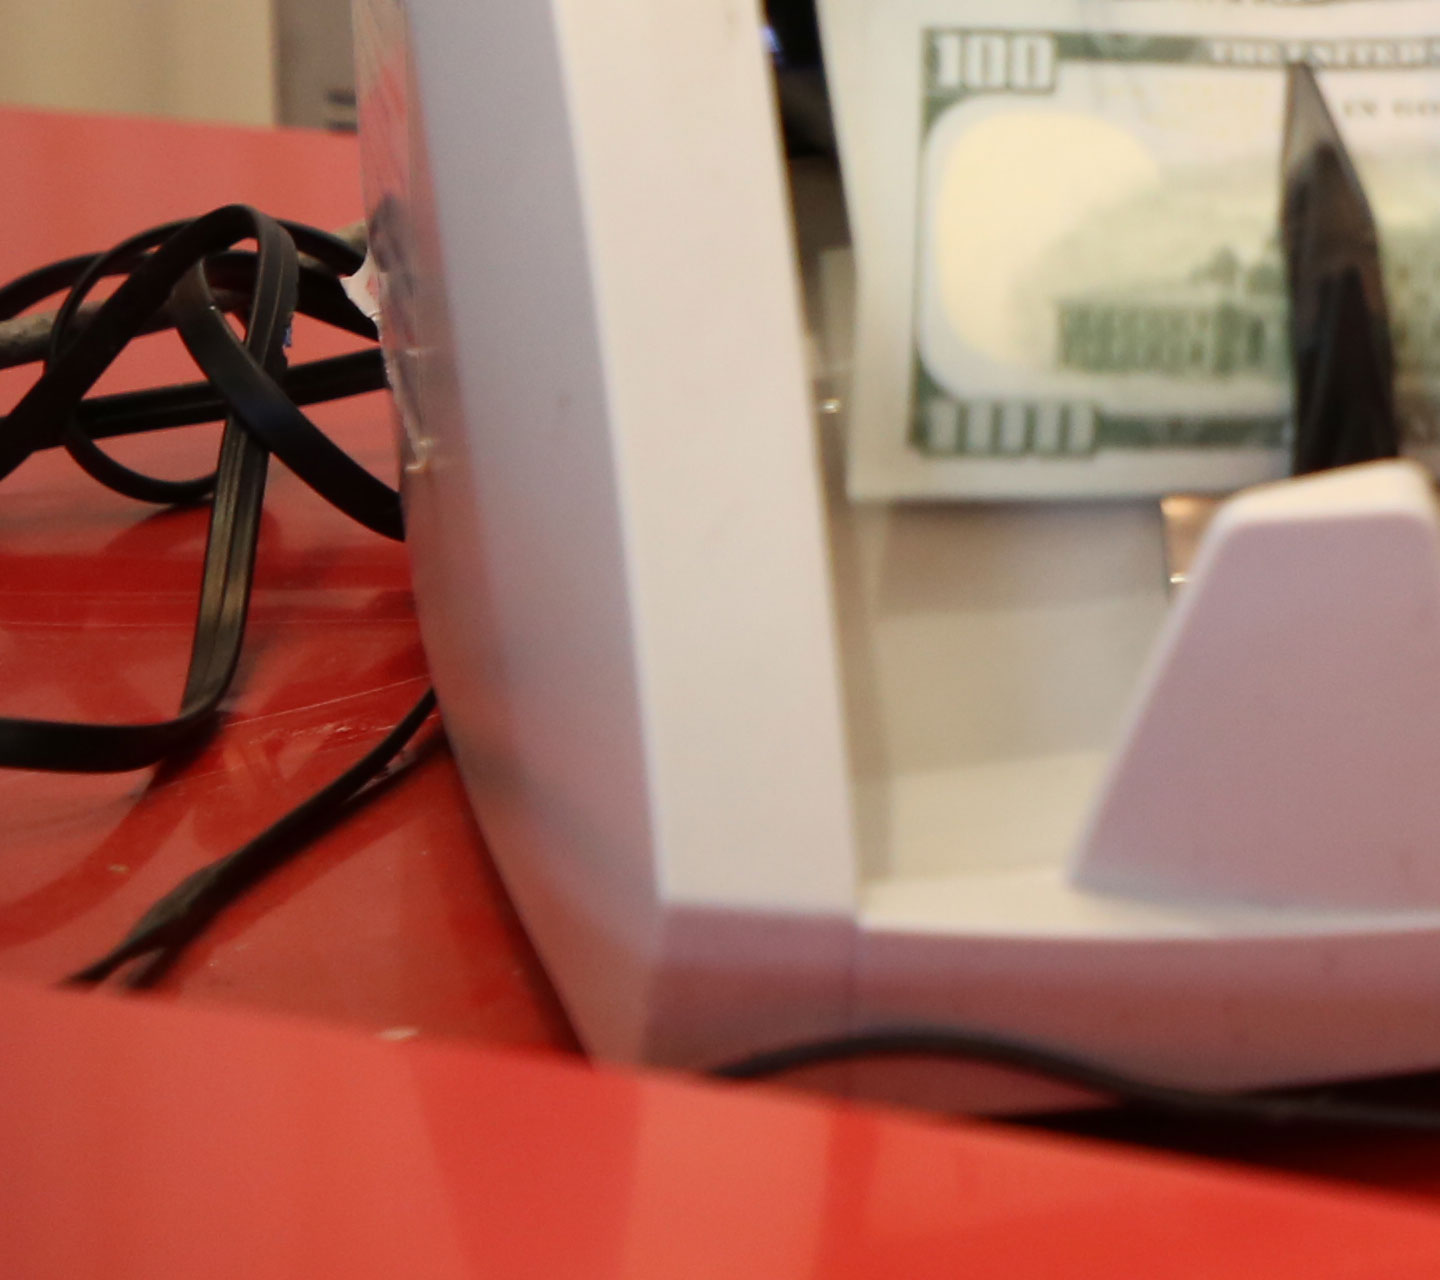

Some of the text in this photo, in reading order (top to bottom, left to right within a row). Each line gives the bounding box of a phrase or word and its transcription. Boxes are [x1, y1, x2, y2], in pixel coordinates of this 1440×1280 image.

[935, 34, 1054, 89] 100
[1207, 41, 1279, 65] THE
[1283, 41, 1427, 65] UNITED
